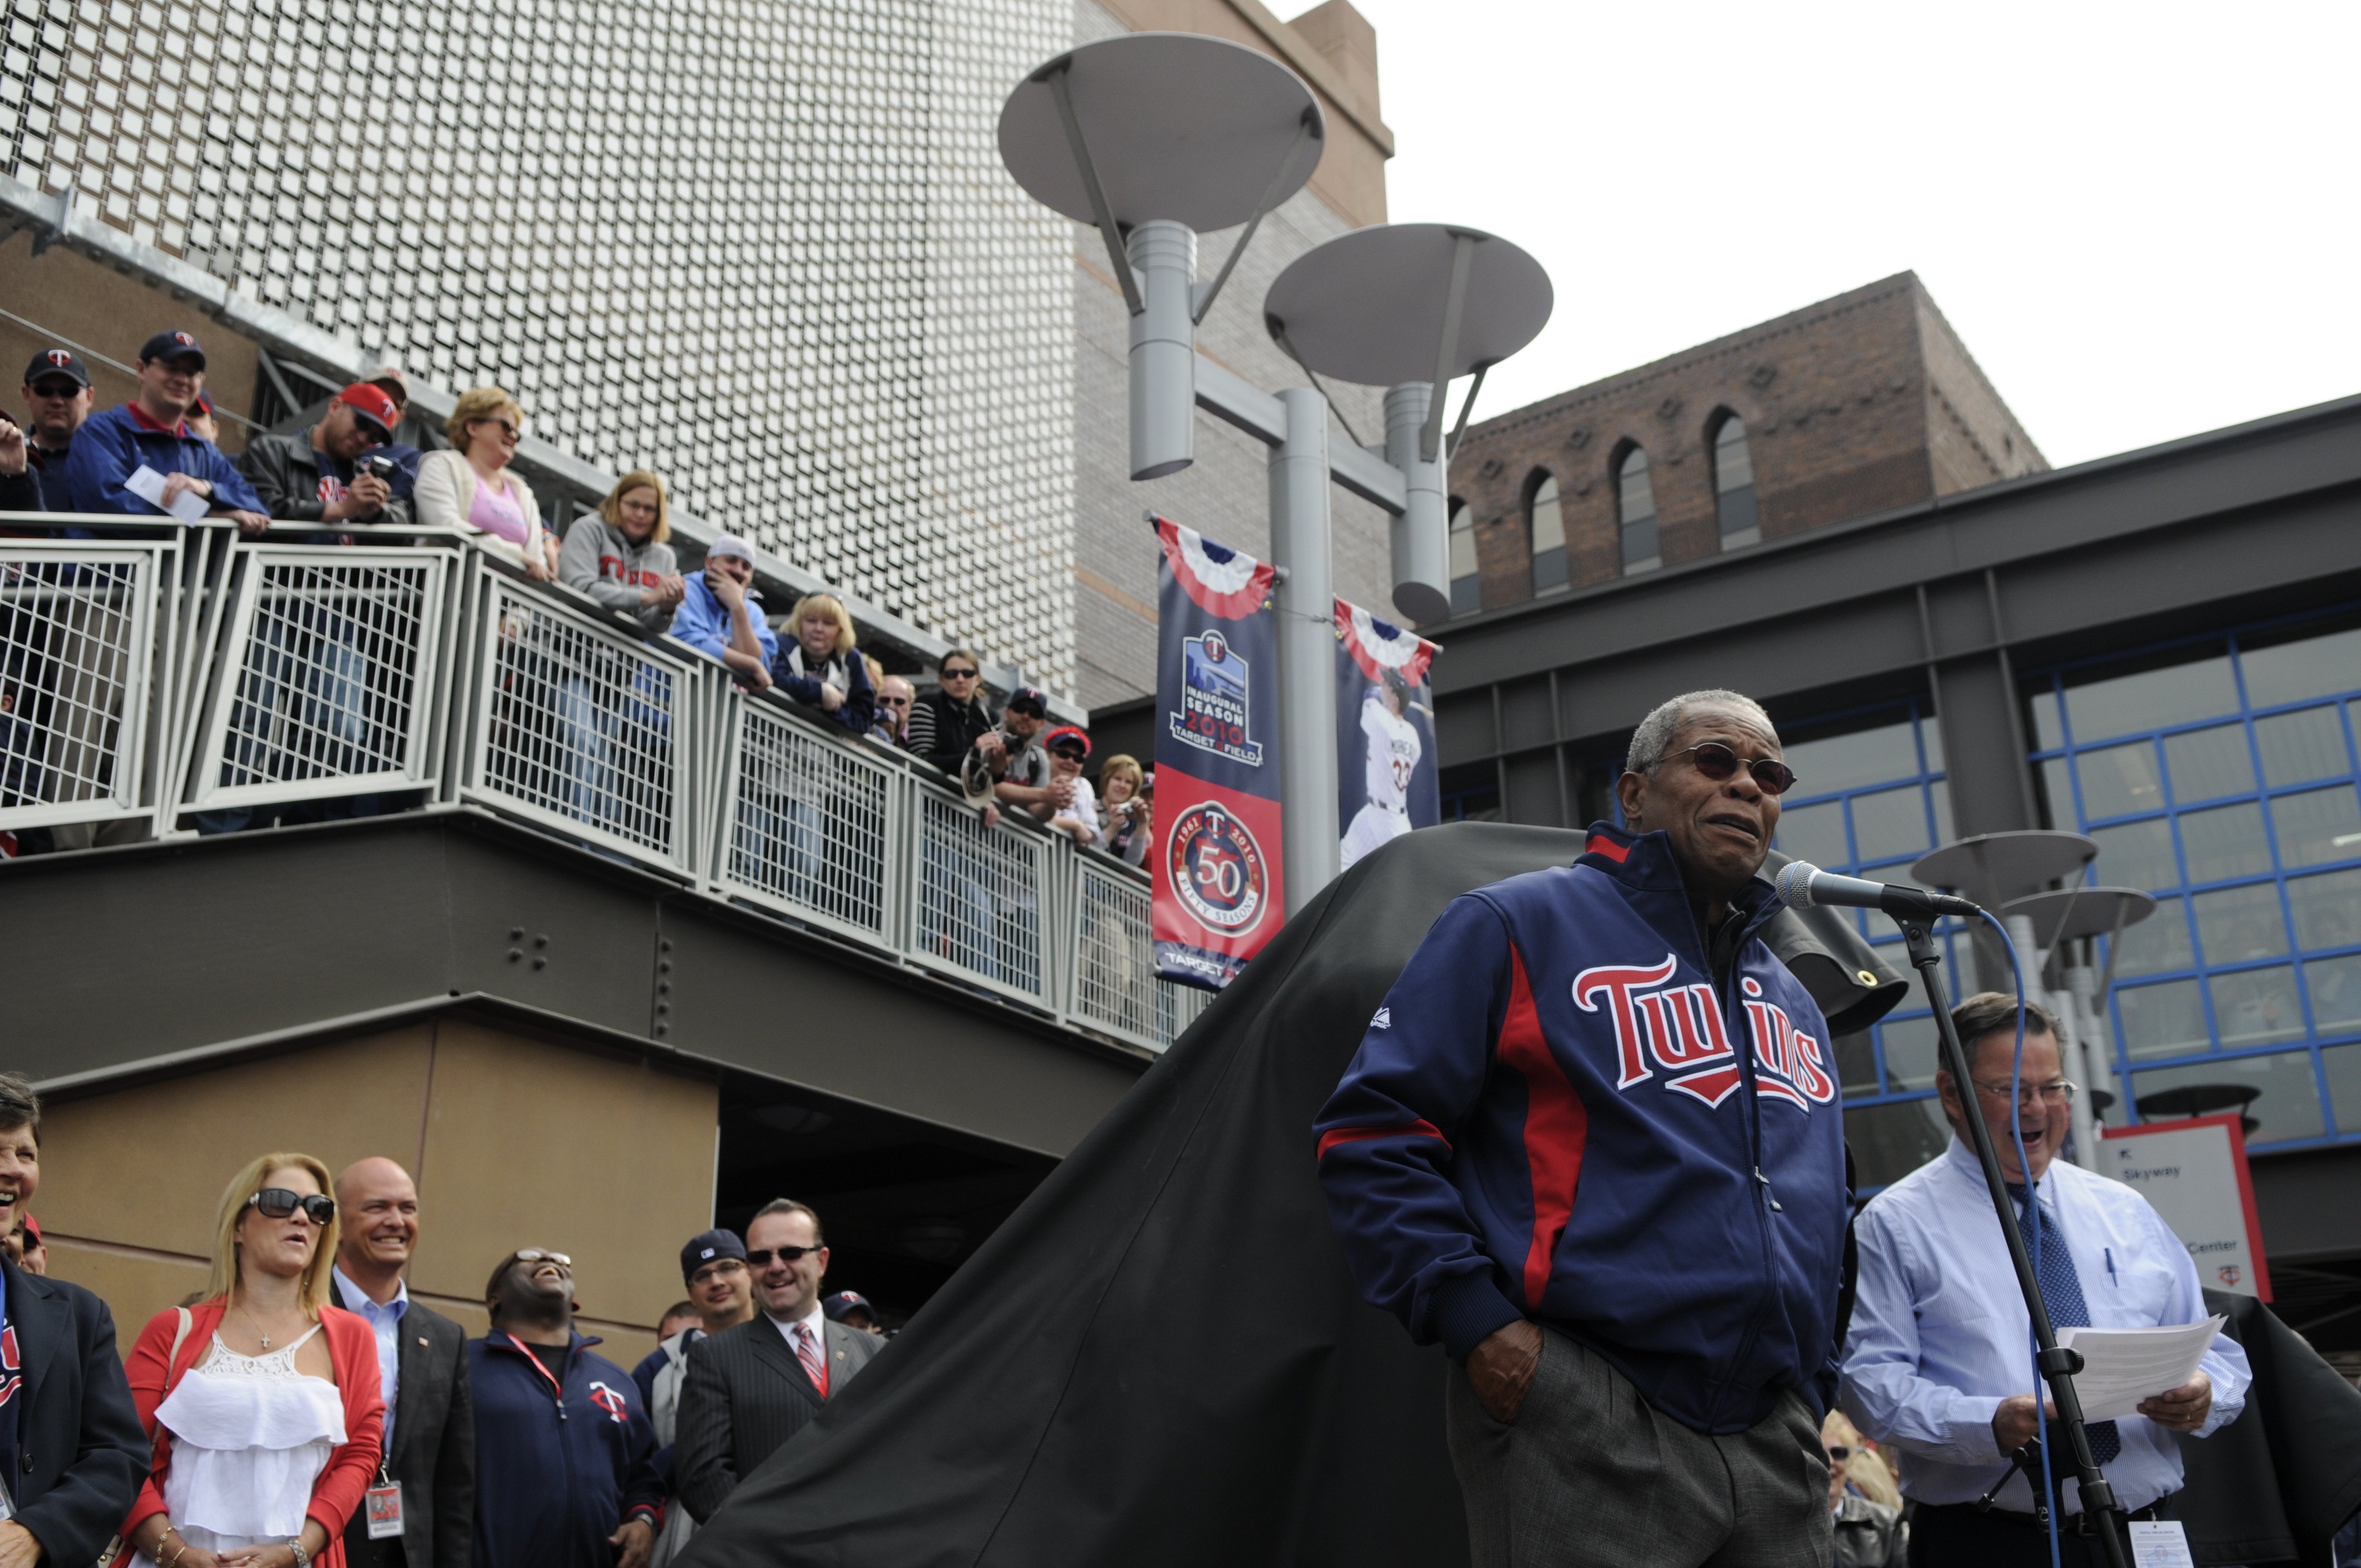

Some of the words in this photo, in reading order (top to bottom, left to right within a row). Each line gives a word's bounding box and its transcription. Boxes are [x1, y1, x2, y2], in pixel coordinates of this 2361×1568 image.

[1187, 685, 1243, 714] INAUGURAL
[1187, 696, 1243, 727] SEASON
[1175, 725, 1216, 747] TARGET
[1224, 744, 1256, 761] FIELD
[1187, 711, 1243, 745] 2010
[1177, 817, 1199, 843] 1961
[1231, 829, 1256, 863] 2010
[1195, 845, 1241, 898] 50
[1180, 878, 1209, 914] FIFTY
[1215, 894, 1255, 924] SEASONS
[1165, 952, 1224, 978] TARGET
[1572, 953, 1835, 1108] Twins
[2123, 1166, 2180, 1182] Skyway
[2188, 1240, 2238, 1255] Center
